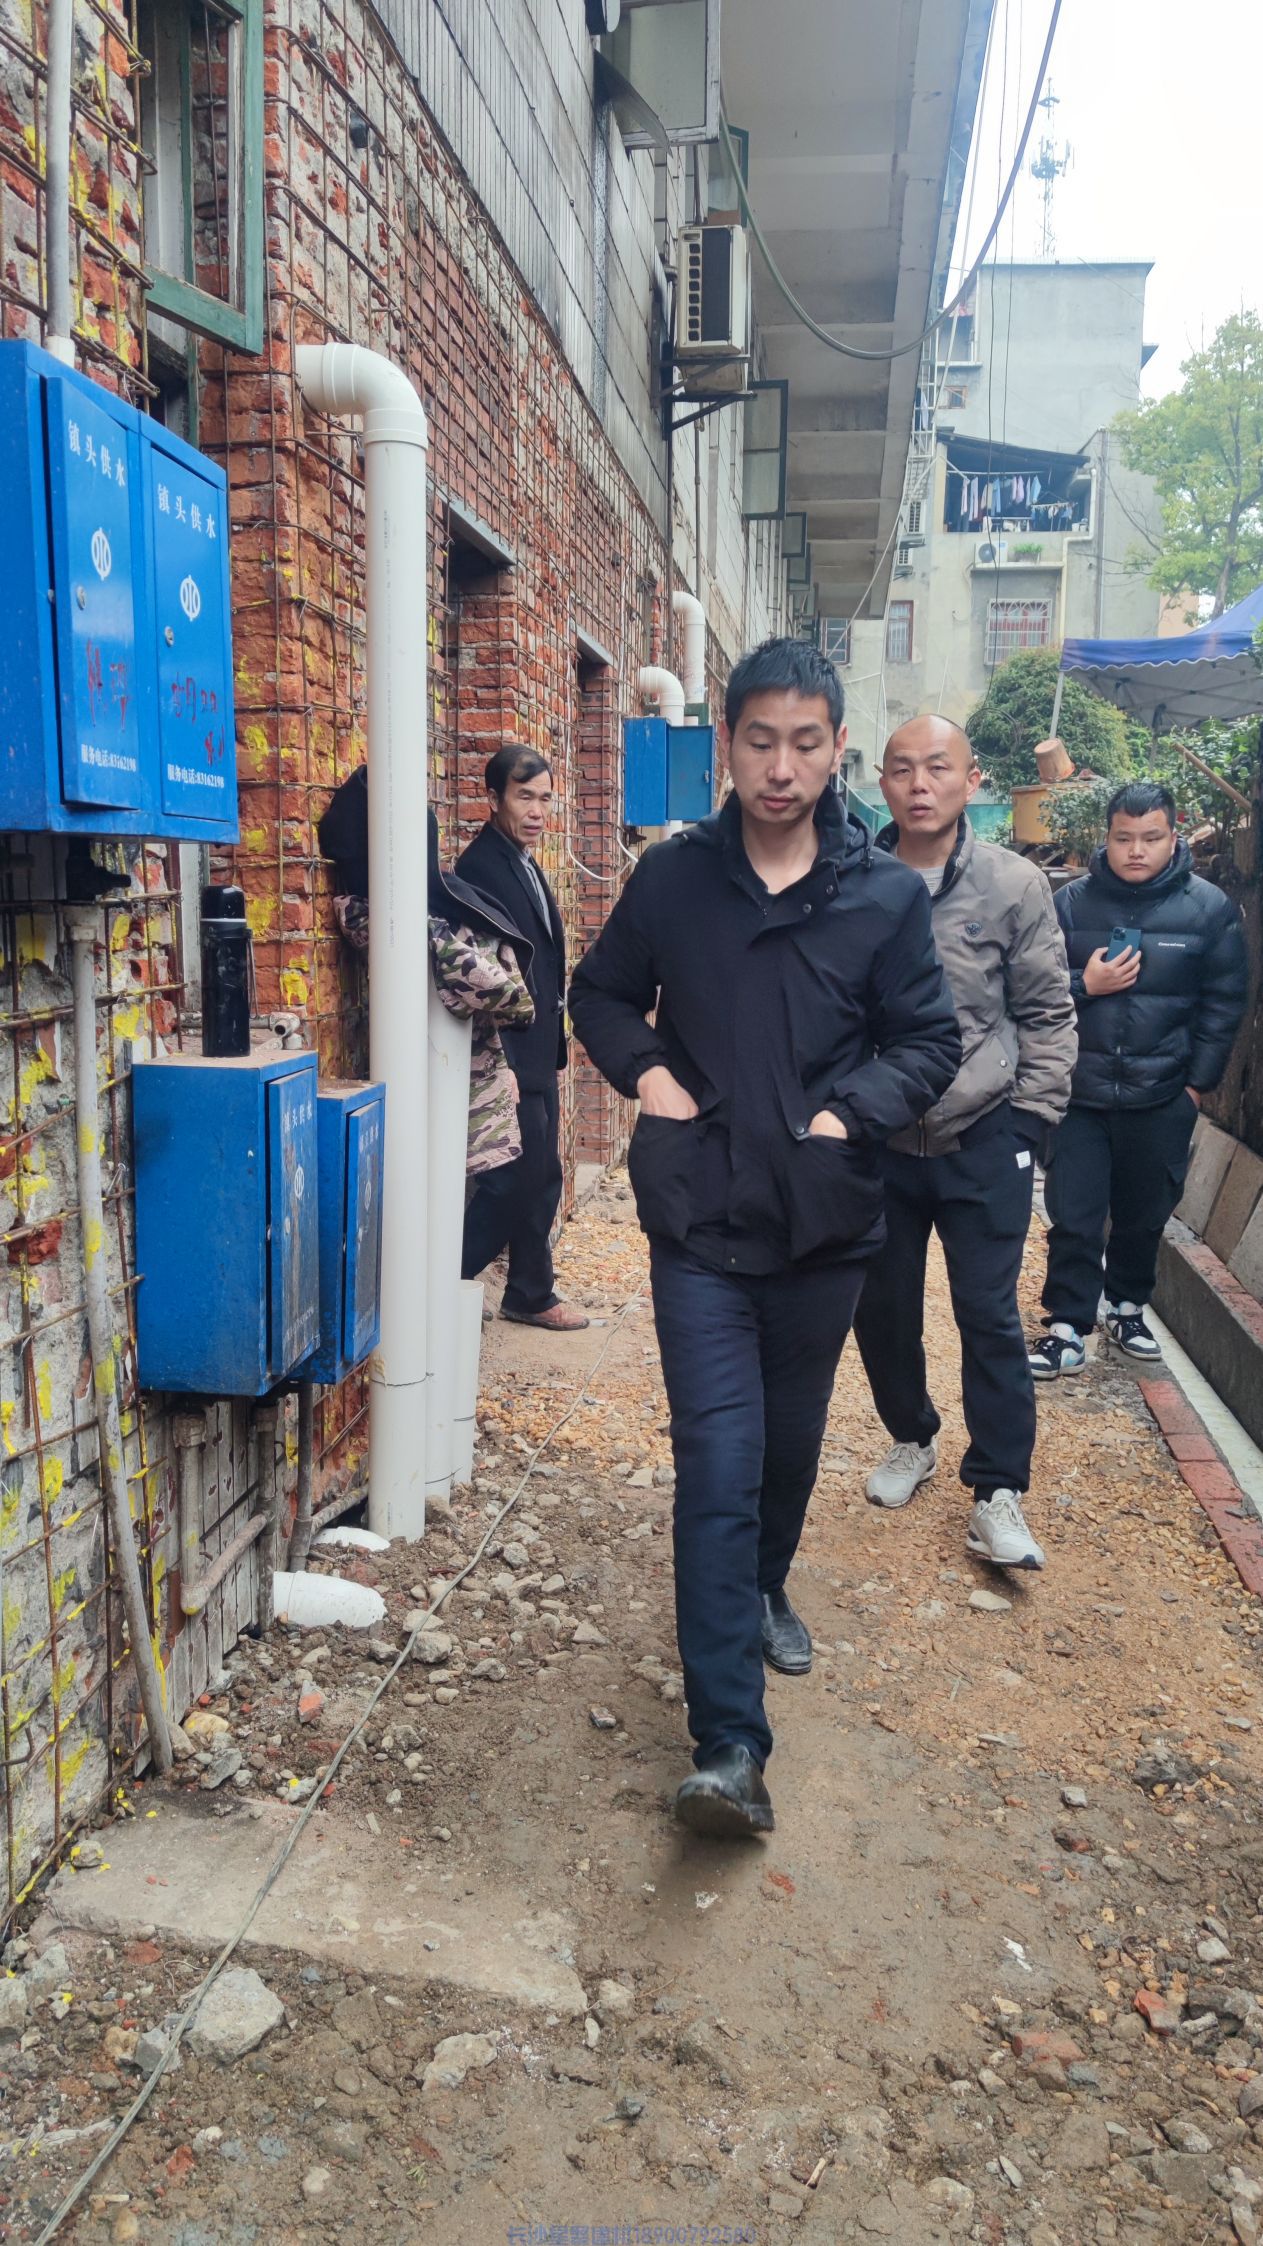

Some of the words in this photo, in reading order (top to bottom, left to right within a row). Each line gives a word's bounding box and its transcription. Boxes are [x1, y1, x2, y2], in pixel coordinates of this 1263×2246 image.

[69, 420, 125, 486] 镇头供水
[158, 483, 216, 538] 镇头供水
